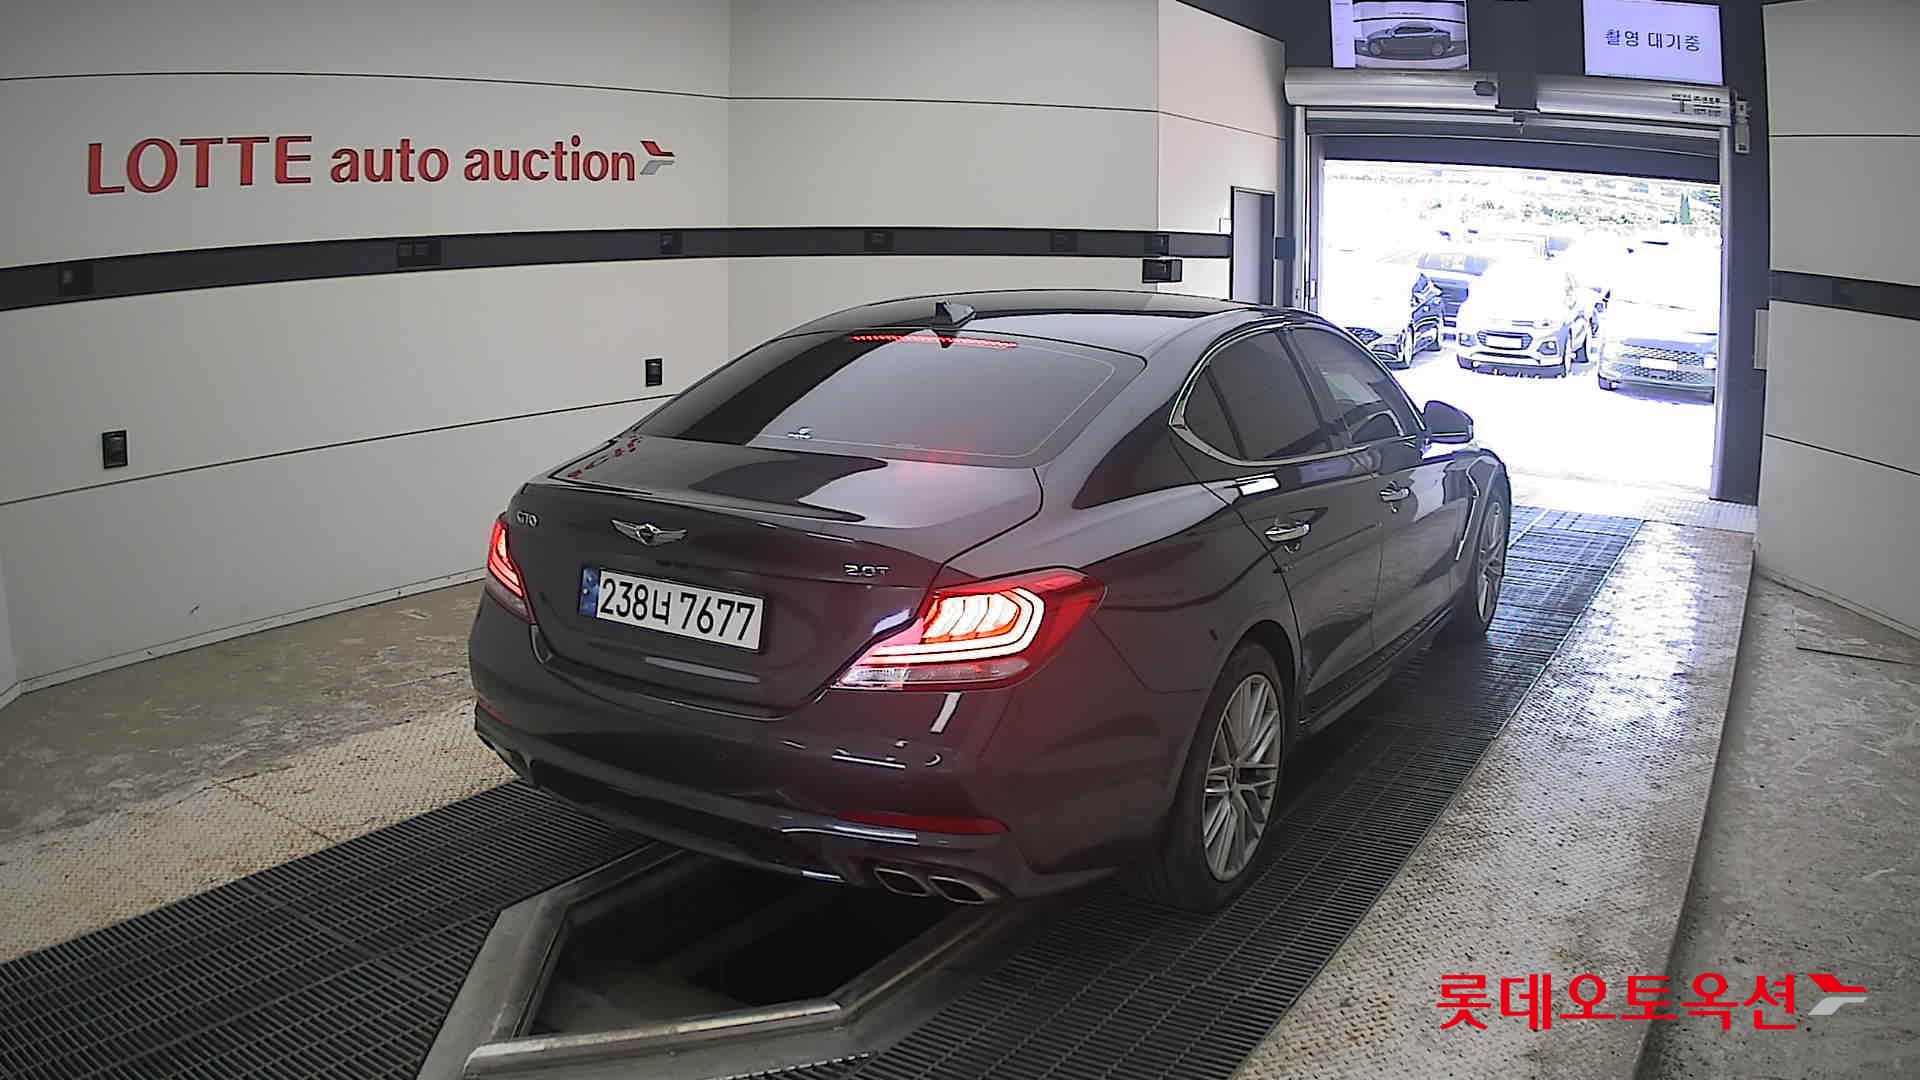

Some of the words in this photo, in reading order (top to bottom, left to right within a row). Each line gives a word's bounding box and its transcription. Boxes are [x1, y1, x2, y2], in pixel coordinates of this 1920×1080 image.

[1603, 29, 1640, 47] 촬영
[87, 135, 312, 195] LOTTE
[329, 138, 450, 183] auto
[463, 135, 636, 182] auction
[600, 578, 672, 626] 238너
[679, 591, 756, 641] 7677
